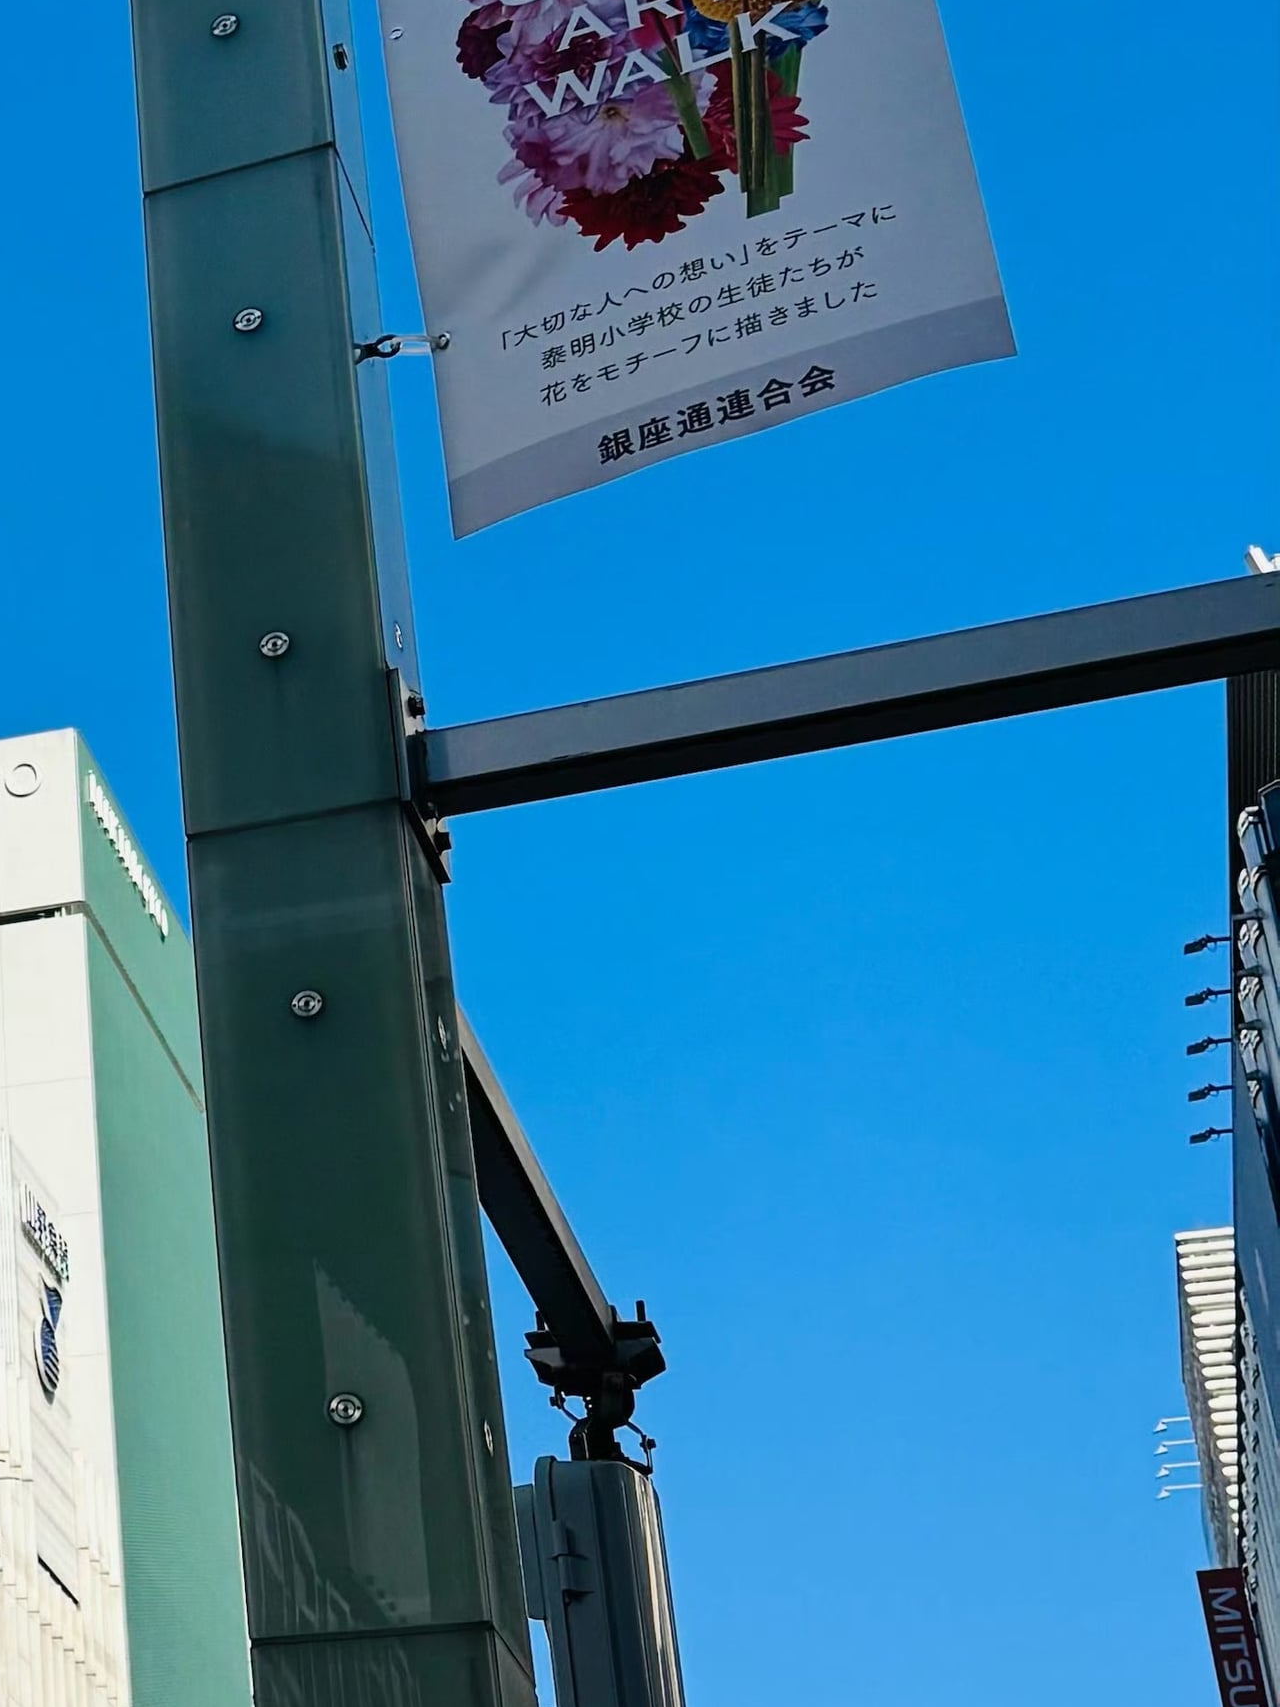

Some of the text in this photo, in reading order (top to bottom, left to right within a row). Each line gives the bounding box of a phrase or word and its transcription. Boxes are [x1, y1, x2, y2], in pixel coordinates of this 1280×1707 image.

[500, 201, 898, 354] 「大切な人への想い」をテーマに
[540, 247, 865, 372] 泰明小学校の生徒たちが
[541, 279, 879, 407] 花をモチーフに描きました
[598, 364, 837, 466] 銀座通連合会
